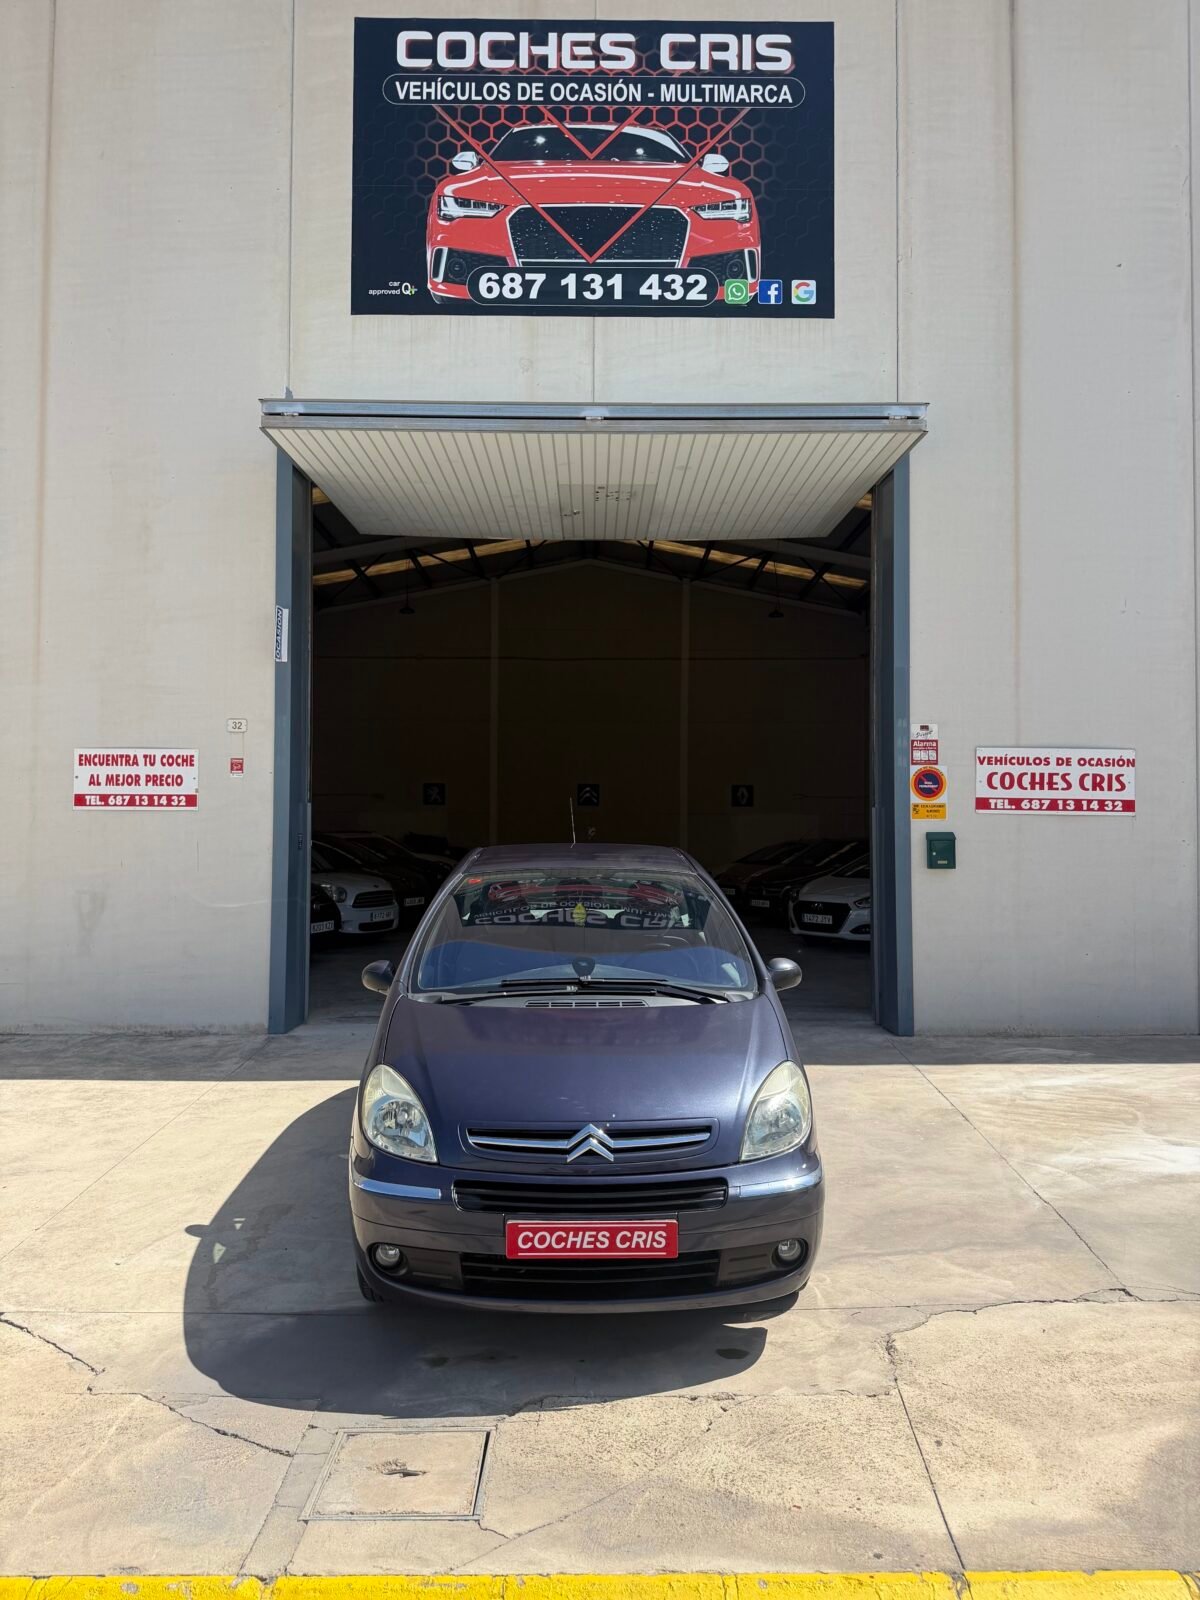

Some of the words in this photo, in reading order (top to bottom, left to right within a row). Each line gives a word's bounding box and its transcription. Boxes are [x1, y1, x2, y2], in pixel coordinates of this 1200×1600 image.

[397, 31, 636, 70] COCHES
[660, 33, 792, 71] CRIS
[395, 77, 511, 101] VEHÍCULOS
[517, 83, 544, 101] DE
[550, 79, 641, 102] OCASIÓN
[660, 84, 793, 103] MULTIMARCA
[478, 273, 547, 300] 687
[560, 273, 623, 300] 131
[639, 274, 708, 300] 432
[232, 721, 243, 730] 32
[78, 754, 139, 767] ENCUENTRA
[143, 754, 156, 767] TU
[160, 754, 195, 767] COCHE
[977, 754, 1050, 766] VEHÍCULOS
[1056, 757, 1072, 766] DE
[1077, 755, 1135, 768] OCASIÓN
[88, 774, 101, 786] AL
[105, 774, 141, 786] MEJOR
[145, 774, 184, 787] PRECIO
[986, 772, 1073, 791] COCHES
[1079, 773, 1126, 792] CRIS
[85, 796, 104, 805] TEL.
[108, 796, 130, 805] 687
[135, 796, 148, 805] 13
[153, 796, 167, 805] 14
[171, 796, 186, 806] 32
[989, 799, 1015, 809] TEL.
[1021, 800, 1050, 810] 687
[1057, 800, 1075, 810] 13
[1081, 800, 1099, 811] 14
[1104, 801, 1123, 811] 32
[517, 1231, 610, 1249] COCHES
[615, 1231, 667, 1249] CRIS
